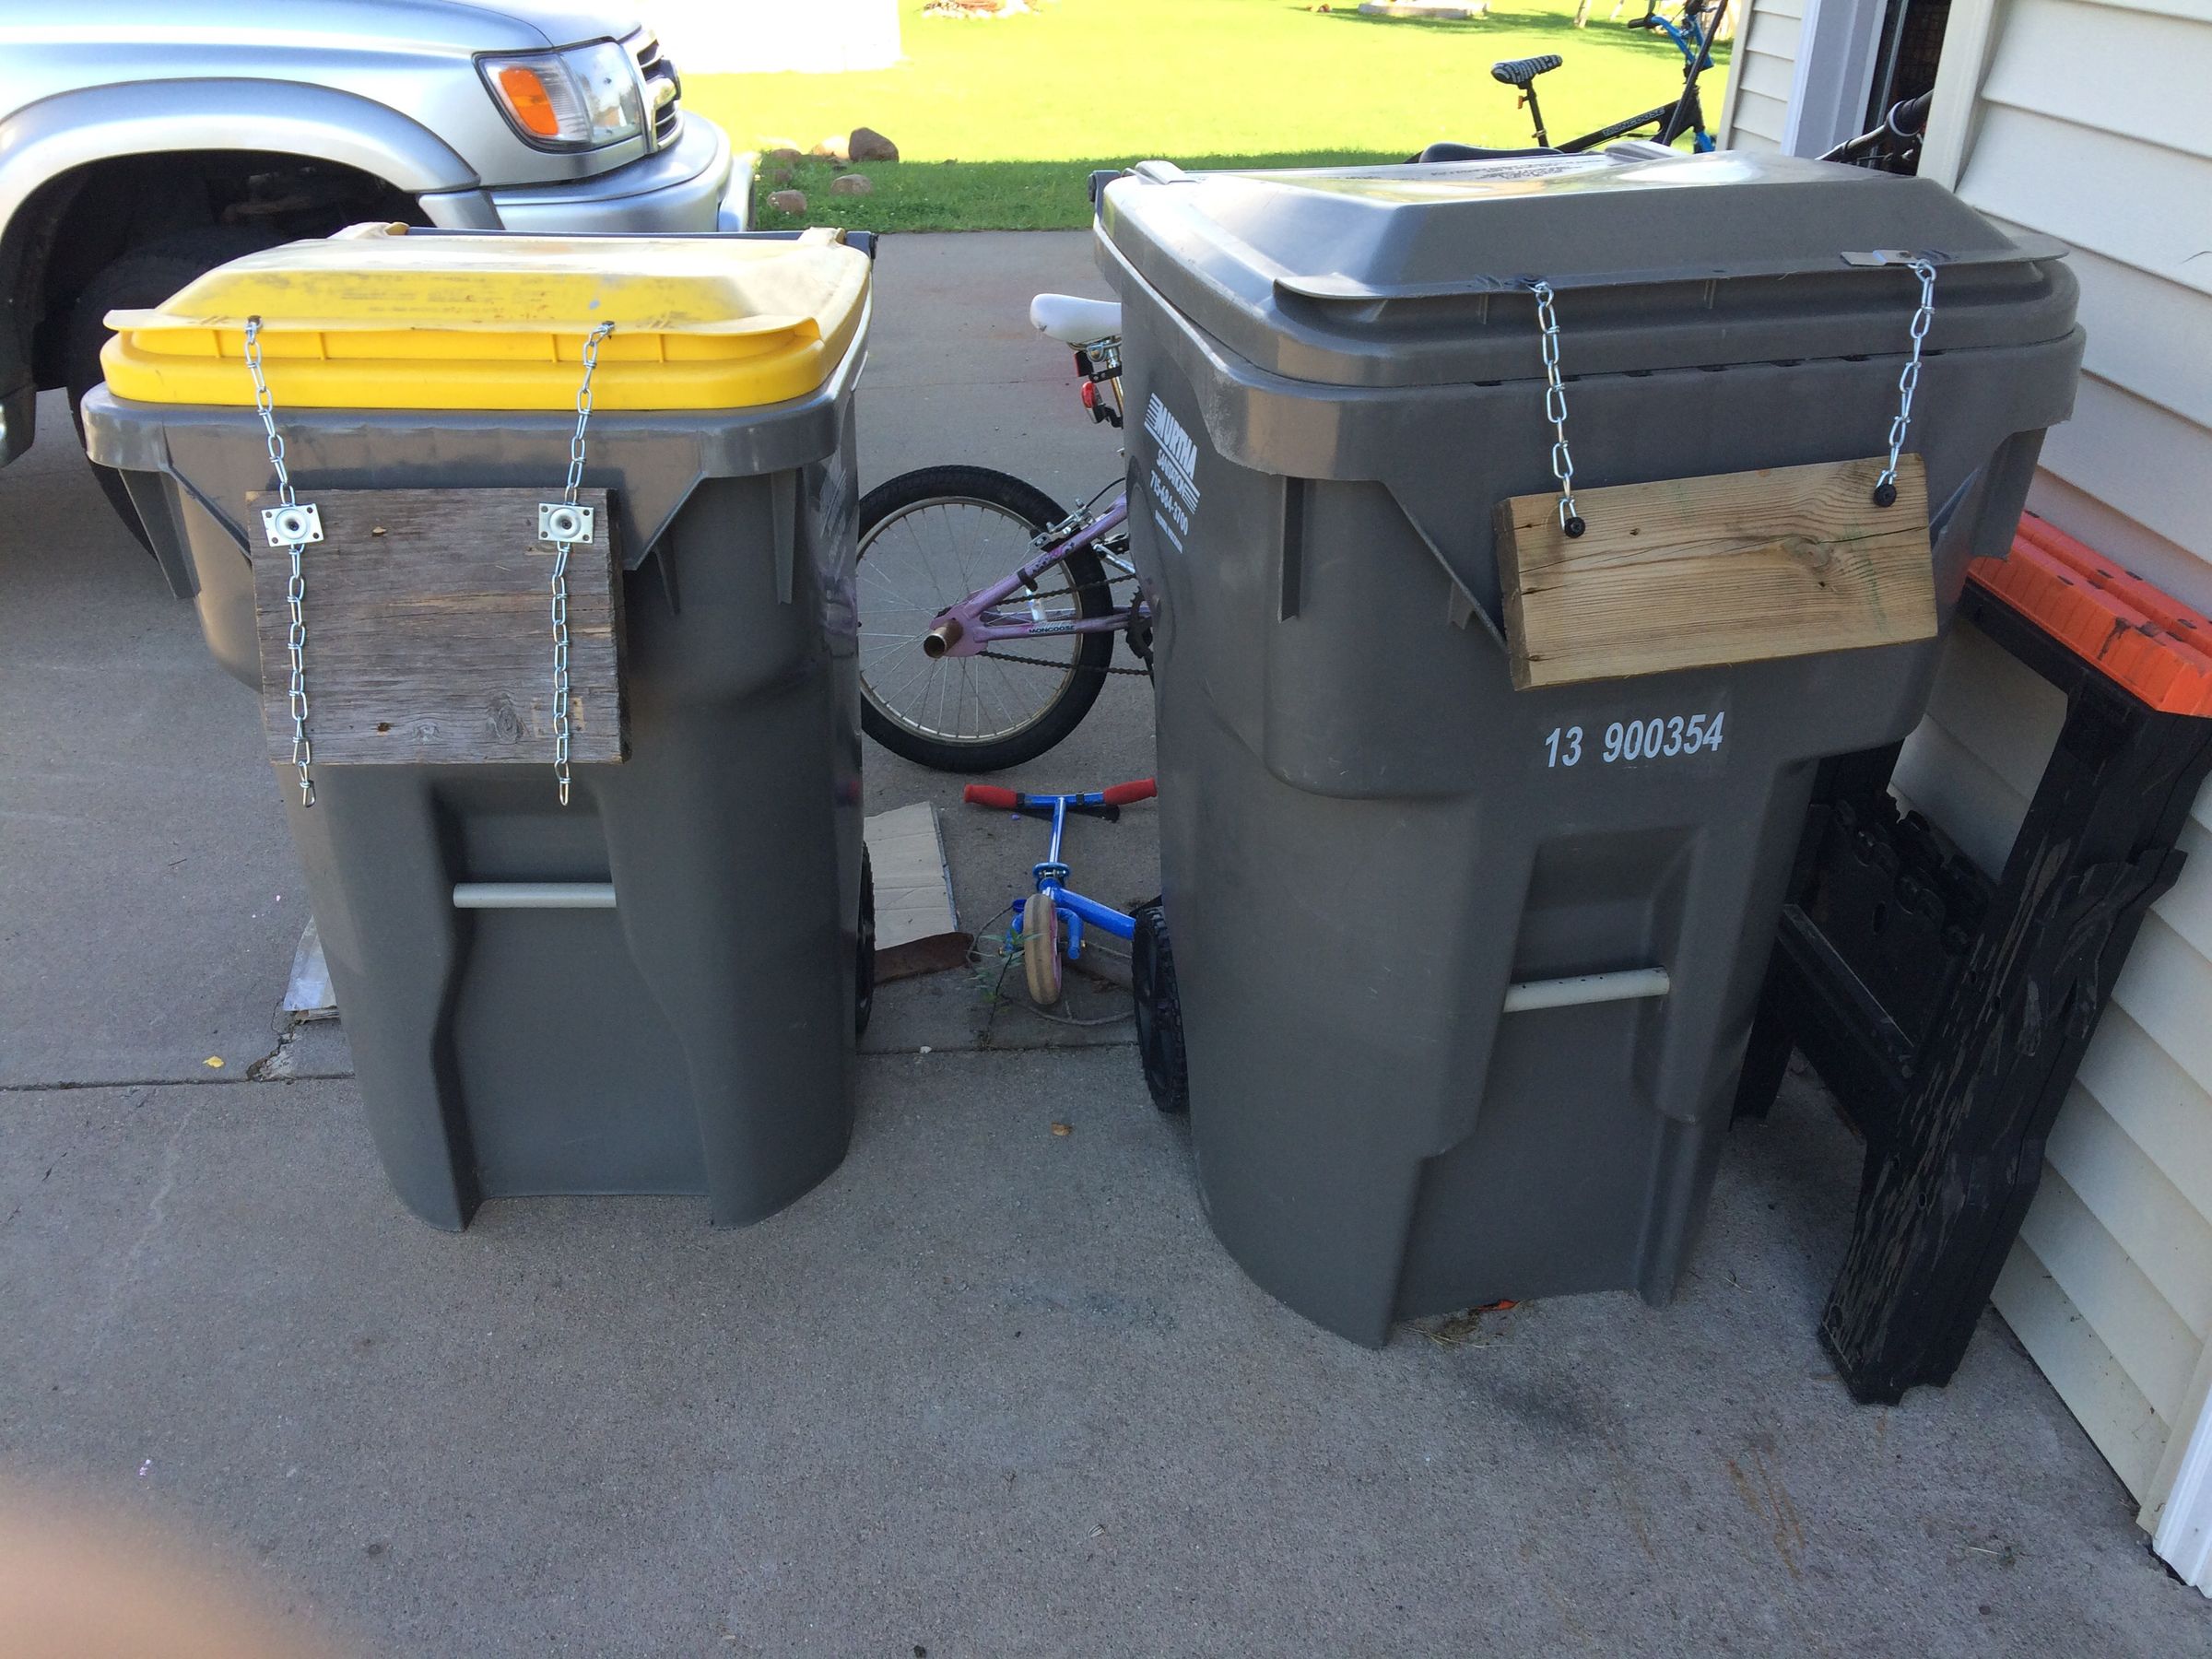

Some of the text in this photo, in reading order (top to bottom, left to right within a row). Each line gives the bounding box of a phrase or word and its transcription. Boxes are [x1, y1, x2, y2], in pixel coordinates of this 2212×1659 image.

[1154, 403, 1198, 480] MURTHA
[1028, 625, 1076, 634] MONGOOSE
[1545, 711, 1725, 768] 13 900354
